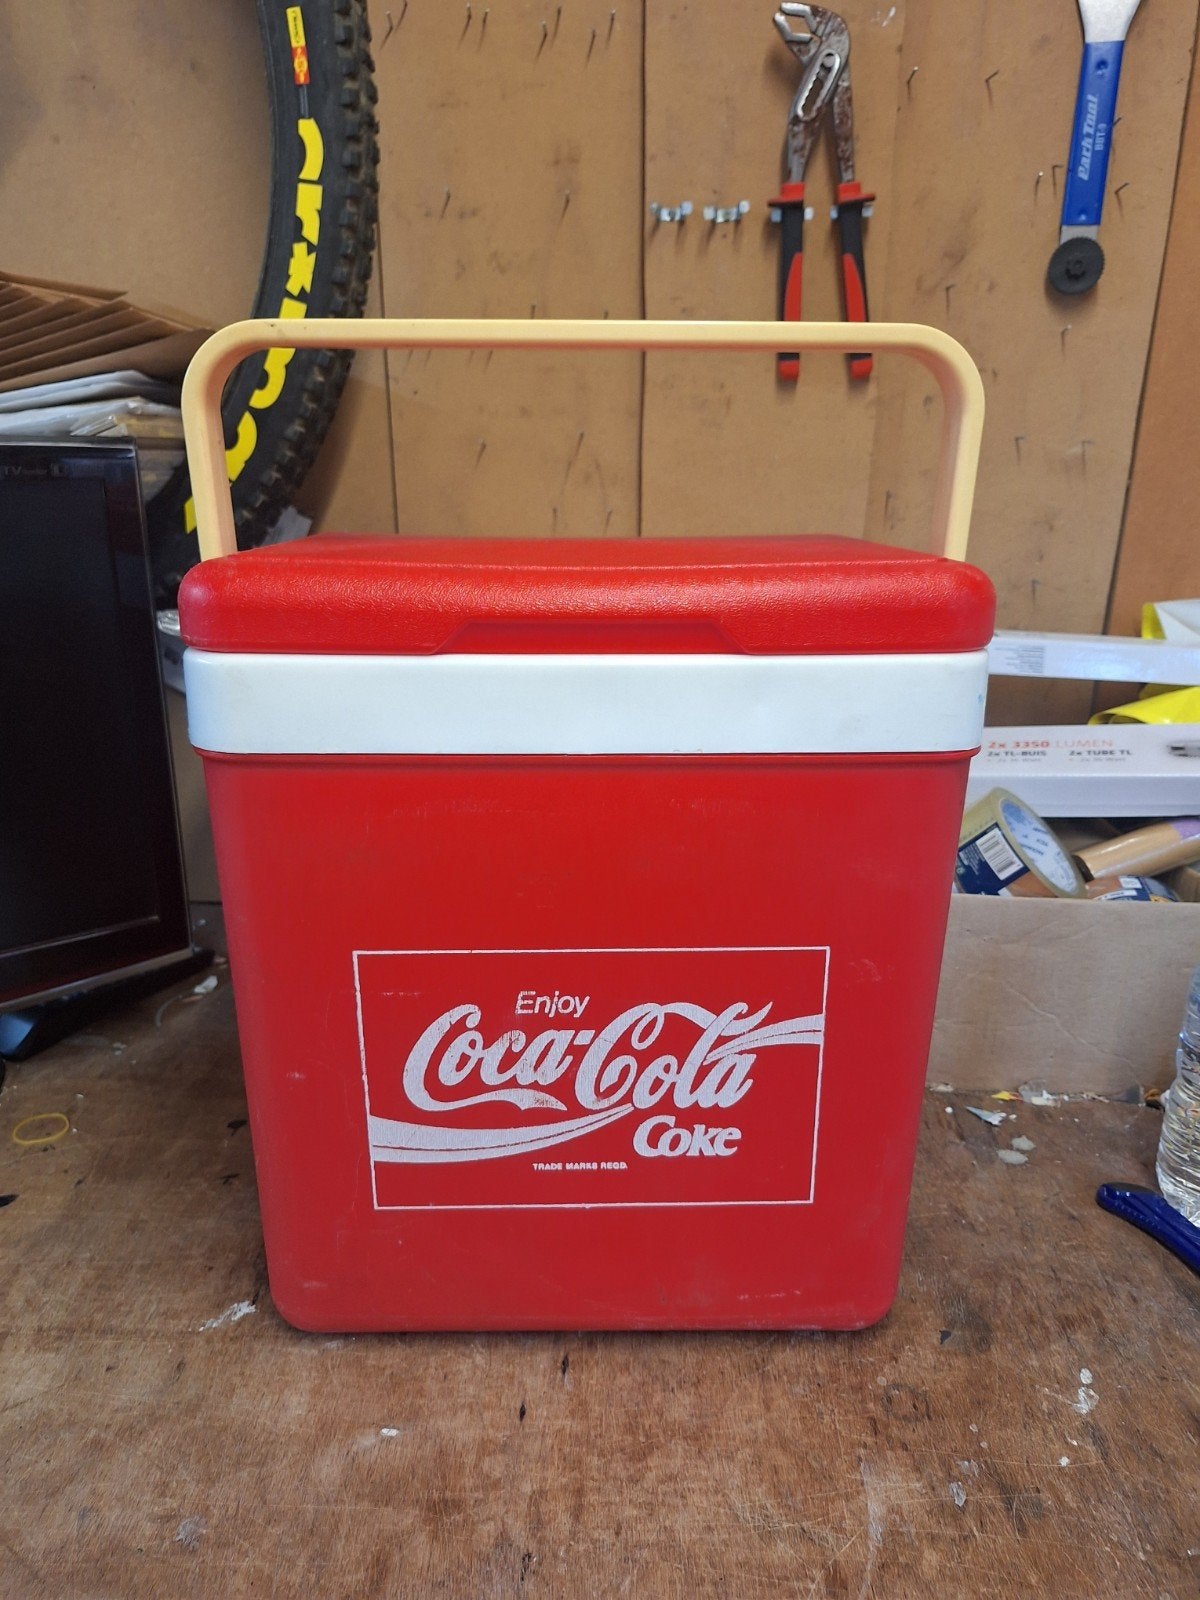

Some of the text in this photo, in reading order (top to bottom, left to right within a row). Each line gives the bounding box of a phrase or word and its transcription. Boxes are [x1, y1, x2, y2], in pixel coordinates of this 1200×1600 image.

[1078, 94, 1098, 181] Park Tool
[1013, 740, 1050, 749] 3350
[1055, 739, 1114, 748] LUMEN
[515, 990, 591, 1018] Enjoy
[402, 1001, 774, 1111] Coca-Cola
[632, 1114, 743, 1157] Coke
[532, 1162, 562, 1171] TRADE
[565, 1161, 598, 1170] MARKS
